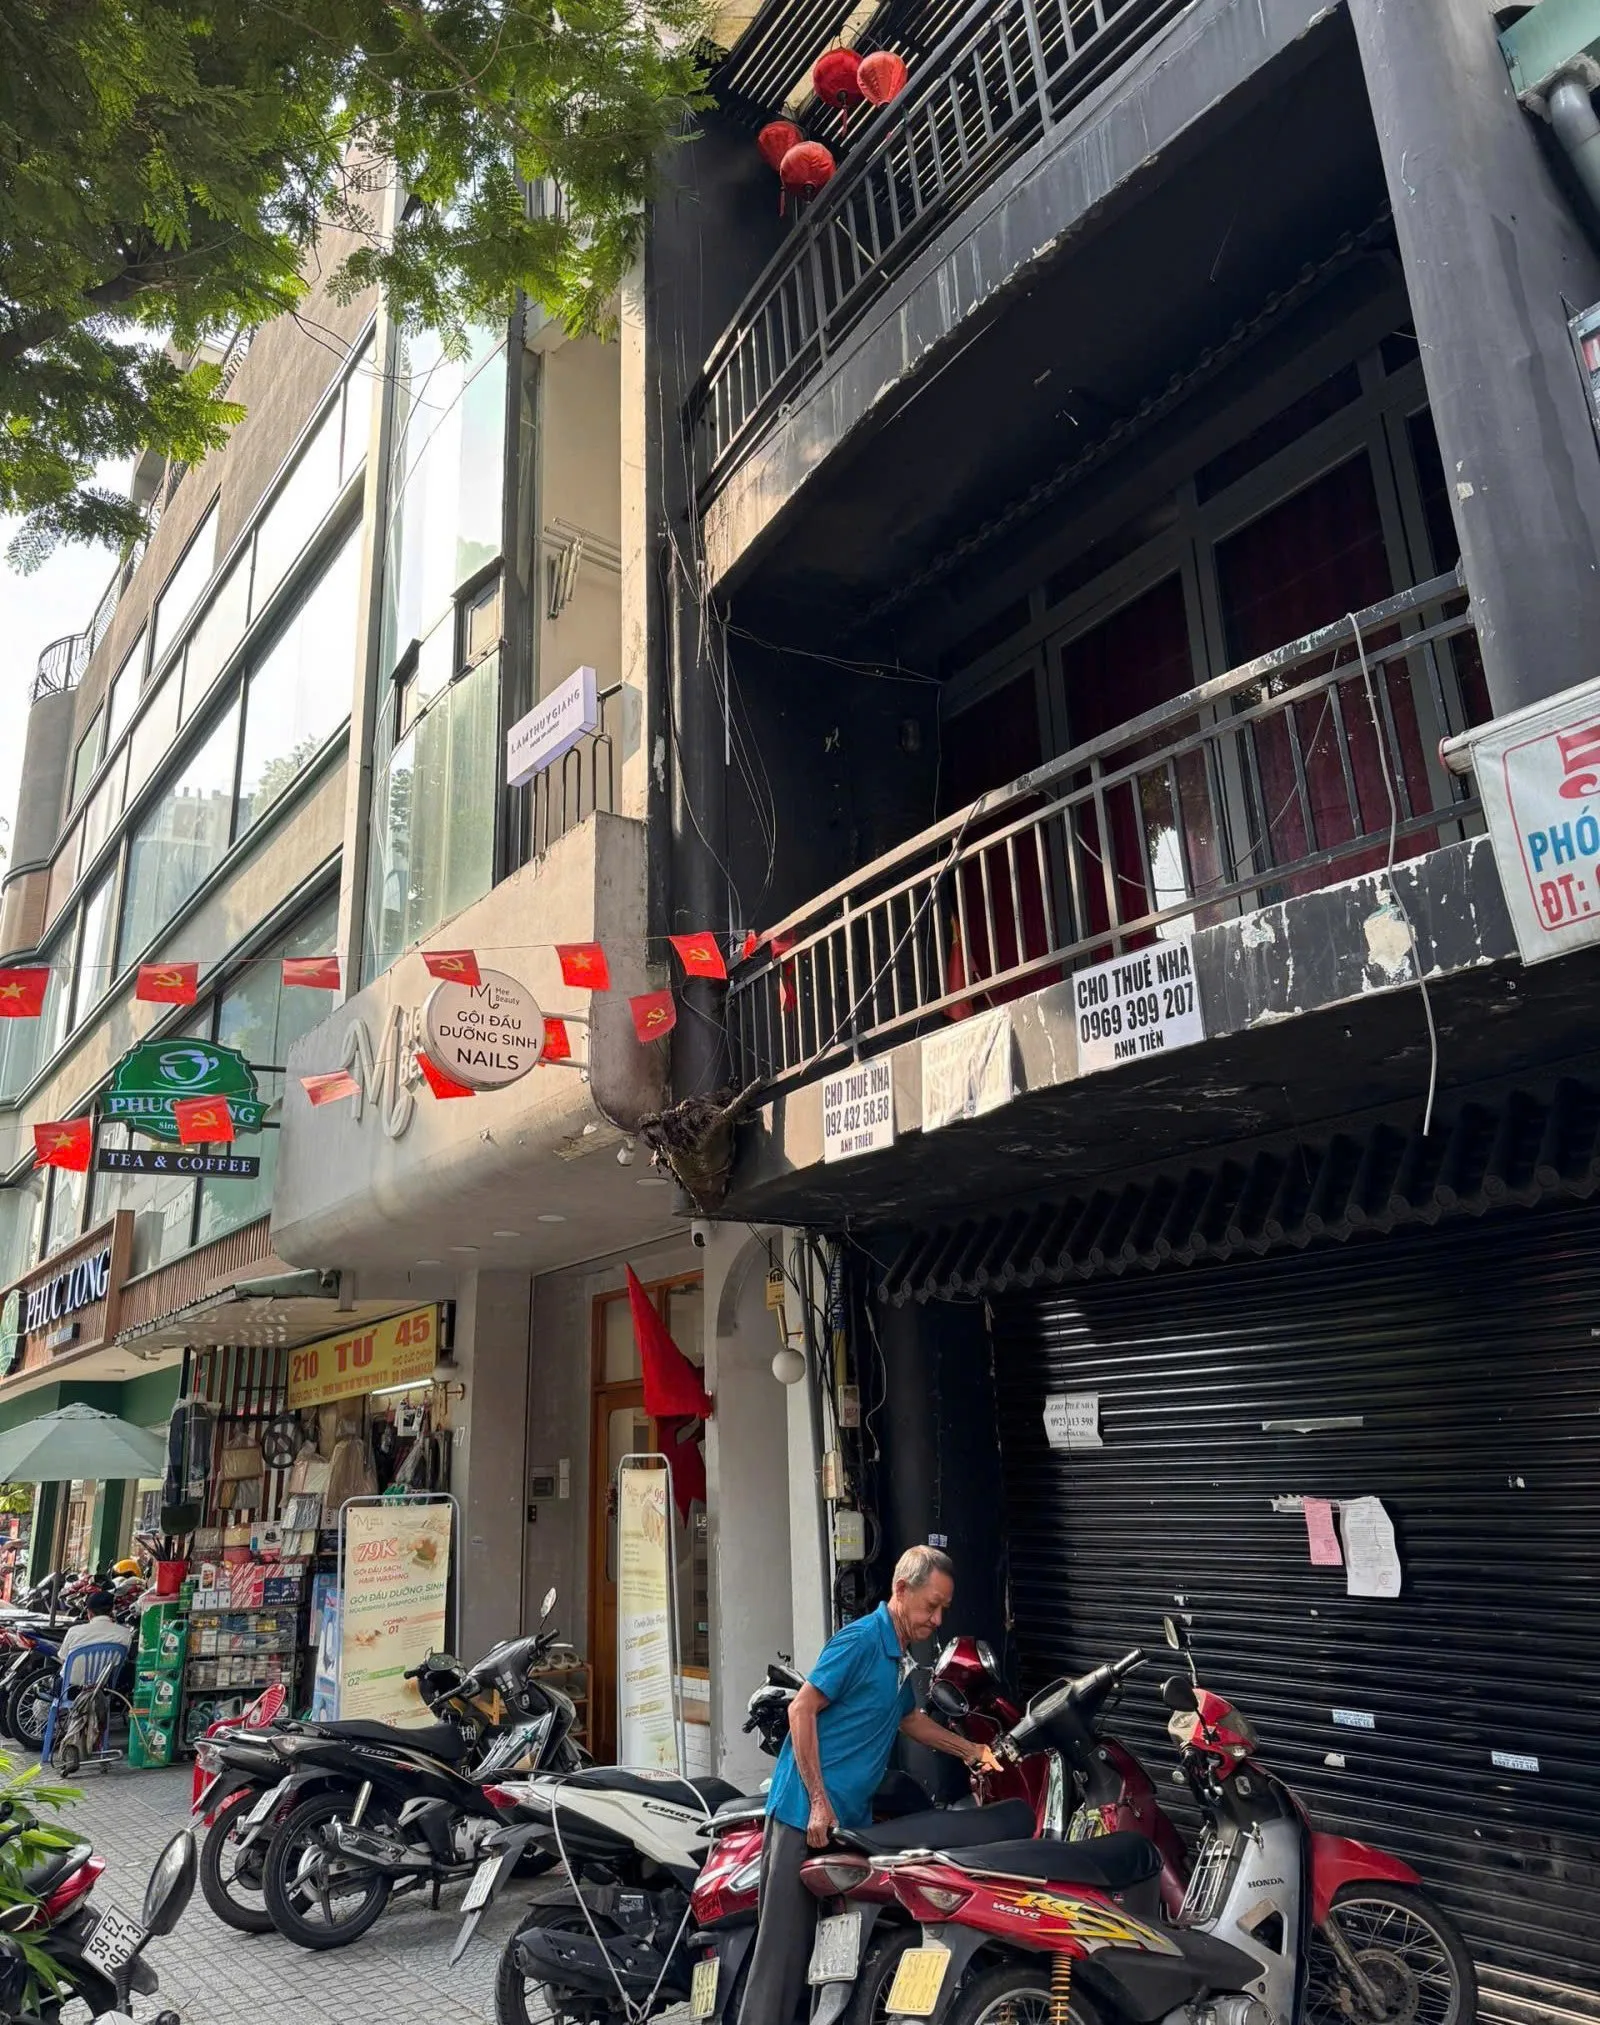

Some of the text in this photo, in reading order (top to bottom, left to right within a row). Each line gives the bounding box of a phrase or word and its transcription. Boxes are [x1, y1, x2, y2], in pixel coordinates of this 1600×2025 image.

[1078, 942, 1191, 1009] CHO THUÊ NHÀ
[495, 995, 520, 1006] Beauty
[457, 1008, 485, 1027] GỘI
[1080, 981, 1193, 1043] 0969 399 207
[439, 1024, 538, 1050] DƯỠNG SINH
[457, 1047, 520, 1071] NAILS
[1114, 1038, 1136, 1059] ANH
[824, 1082, 843, 1109] CHO
[844, 1068, 868, 1104] THUÊ
[871, 1062, 890, 1094] NHÀ
[825, 1096, 889, 1138] 092 432 58.58
[840, 1138, 853, 1154] ANH
[108, 1153, 251, 1173] TEA & COFFEE
[64, 1247, 111, 1315] LONG
[293, 1351, 319, 1384] 210
[335, 1328, 379, 1373] TƯ
[394, 1313, 430, 1347] 45
[357, 1537, 398, 1563] 79K
[425, 1581, 445, 1592] SINH
[388, 1625, 400, 1635] 01
[347, 1677, 360, 1687] 02
[1247, 1877, 1285, 1889] HONDA
